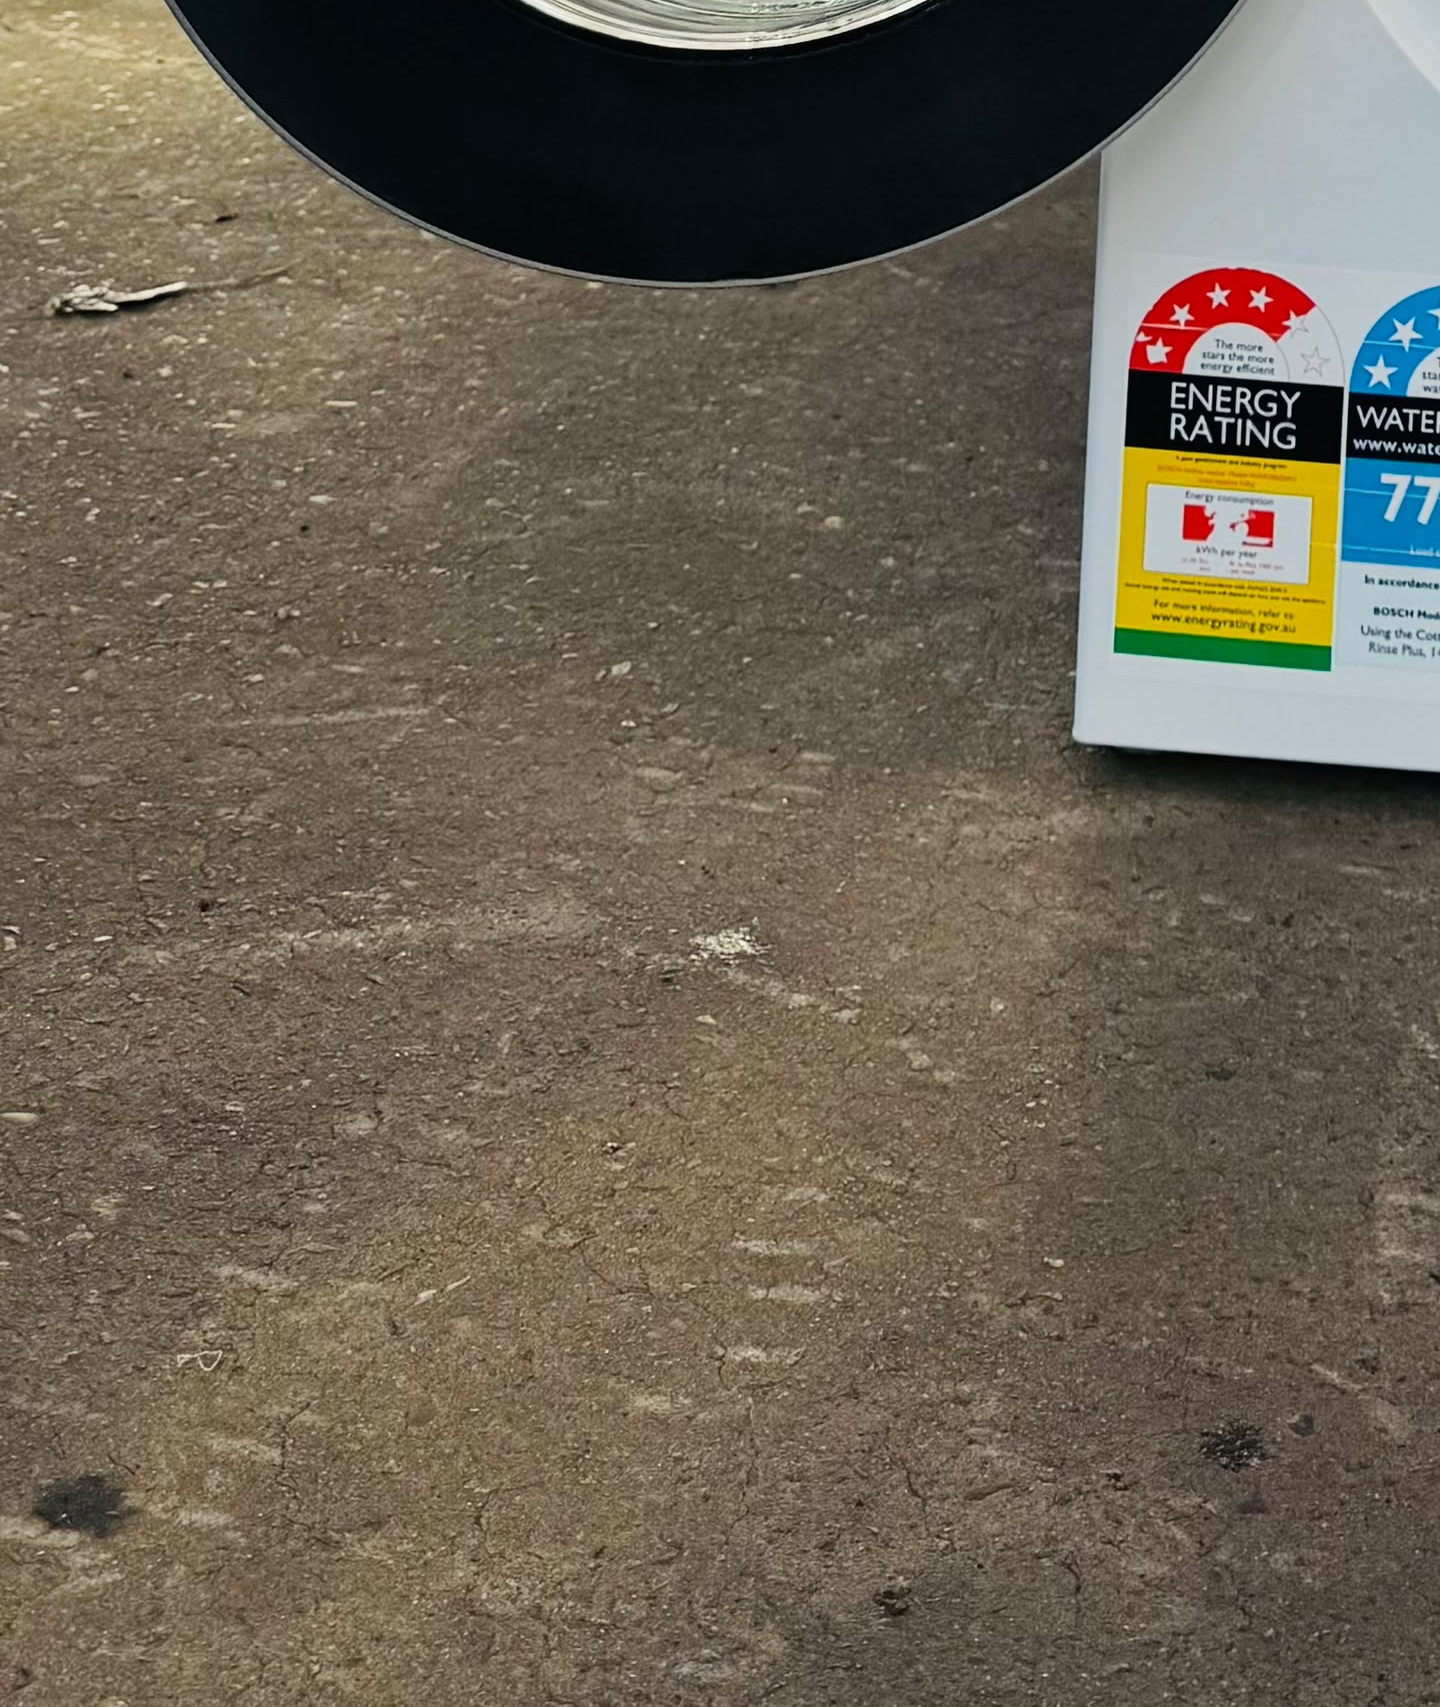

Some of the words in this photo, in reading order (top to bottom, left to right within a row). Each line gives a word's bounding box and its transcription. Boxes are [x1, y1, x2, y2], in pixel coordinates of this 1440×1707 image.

[1215, 339, 1233, 350] The
[1236, 342, 1263, 353] more
[1202, 351, 1225, 361] stars
[1228, 352, 1244, 362] the
[1248, 354, 1274, 364] more
[1200, 361, 1233, 374] energy
[1236, 363, 1275, 376] efficient
[1170, 381, 1301, 419] ENERGY
[1169, 414, 1297, 450] RATING
[1185, 490, 1214, 503] Energy
[1217, 494, 1274, 506] consumption
[1220, 548, 1235, 557] per
[1239, 550, 1258, 559] year
[1364, 574, 1375, 585] In
[1378, 577, 1440, 590] accordance
[1154, 598, 1170, 609] For
[1173, 601, 1197, 612] more
[1258, 608, 1281, 618] refer
[1373, 606, 1414, 619] BOSCH
[1151, 612, 1297, 634] www.energyrating.gov.au
[1360, 624, 1391, 640] Using
[1394, 626, 1412, 639] the
[1367, 641, 1398, 655] Rinse
